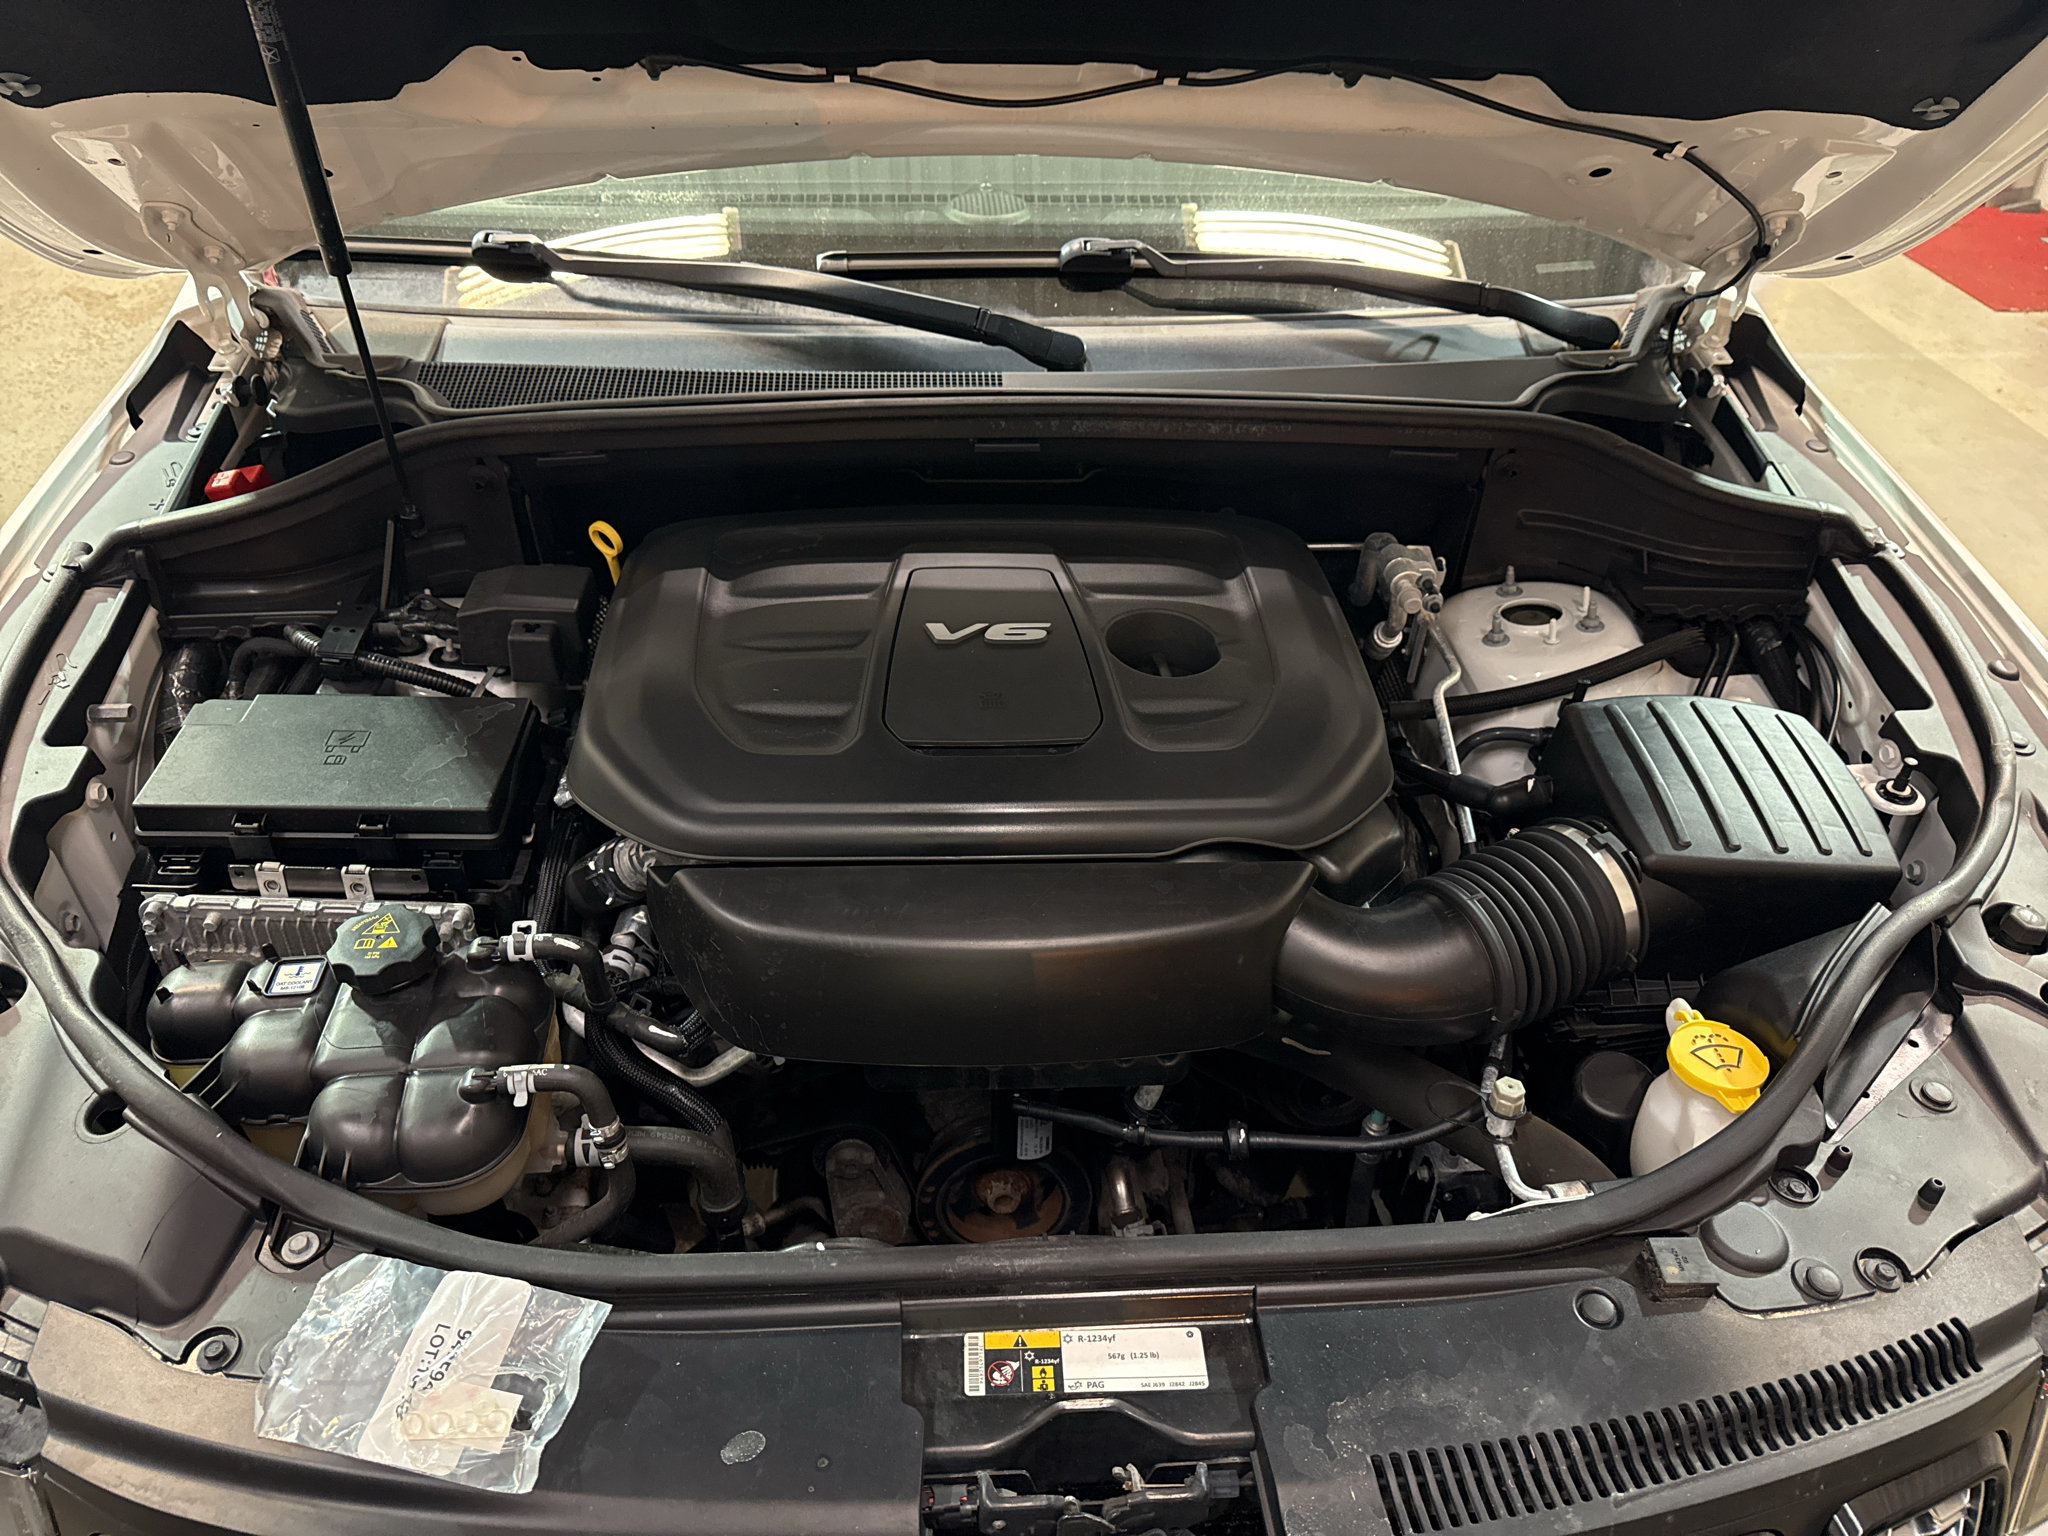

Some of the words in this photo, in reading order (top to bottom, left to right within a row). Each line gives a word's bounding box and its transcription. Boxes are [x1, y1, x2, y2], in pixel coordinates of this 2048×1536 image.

[924, 622, 1052, 643] V6
[1077, 1334, 1116, 1344] R-1234yf
[1107, 1352, 1125, 1360] 567g
[1130, 1351, 1149, 1360] (1.25
[1149, 1351, 1160, 1359] lb)
[1034, 1357, 1060, 1365] R-1234yf
[1086, 1381, 1105, 1389] PAG
